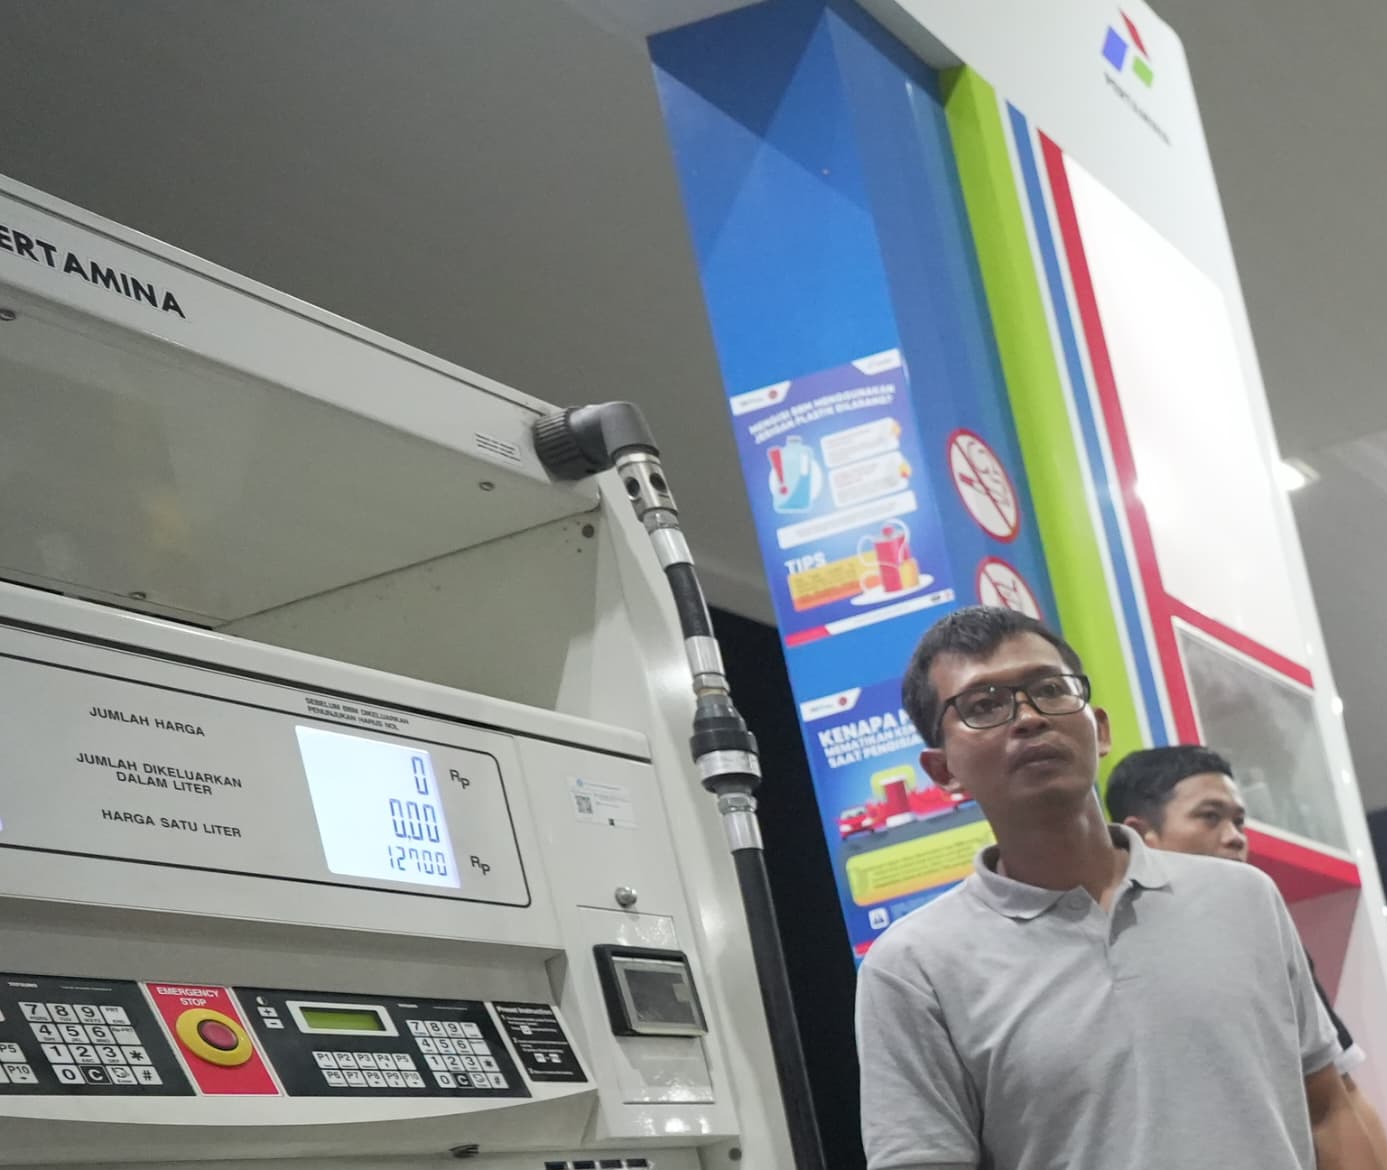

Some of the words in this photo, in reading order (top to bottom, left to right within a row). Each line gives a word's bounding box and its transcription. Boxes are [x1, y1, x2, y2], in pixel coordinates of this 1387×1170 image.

[784, 552, 827, 574] TIPS
[89, 707, 150, 726] JUMLAH
[154, 718, 205, 736] HARGA
[818, 712, 898, 748] KENAPA
[76, 753, 137, 771] JUMLAH
[143, 763, 242, 788] DIKELUARKAN
[411, 756, 429, 795] 0
[116, 771, 168, 788] DALAM
[173, 781, 212, 796] LITER
[101, 809, 155, 826] HARGA
[160, 817, 198, 832] SATU
[203, 824, 242, 838] LITER
[389, 798, 440, 843] 0.00
[388, 845, 448, 877] 12700
[156, 986, 219, 998] EMERGENCY
[180, 997, 207, 1007] STOP
[24, 1003, 38, 1015] 7
[55, 1004, 69, 1017] 8
[82, 1006, 95, 1018] 9
[39, 1024, 52, 1036] 4
[66, 1025, 79, 1037] 5
[93, 1026, 106, 1038] 6
[430, 1022, 441, 1032] 8
[447, 1023, 458, 1032] 9
[421, 1039, 432, 1048] 4
[439, 1039, 449, 1049] 5
[456, 1040, 467, 1049] 6
[50, 1045, 62, 1057] 1
[76, 1046, 92, 1057] 2
[105, 1047, 117, 1058] 3
[337, 1054, 351, 1062] P2
[449, 1056, 461, 1066] 2
[466, 1057, 476, 1066] 3
[8, 1065, 30, 1074] P10
[62, 1068, 76, 1081] 0
[88, 1069, 103, 1081] C
[457, 1075, 469, 1085] C
